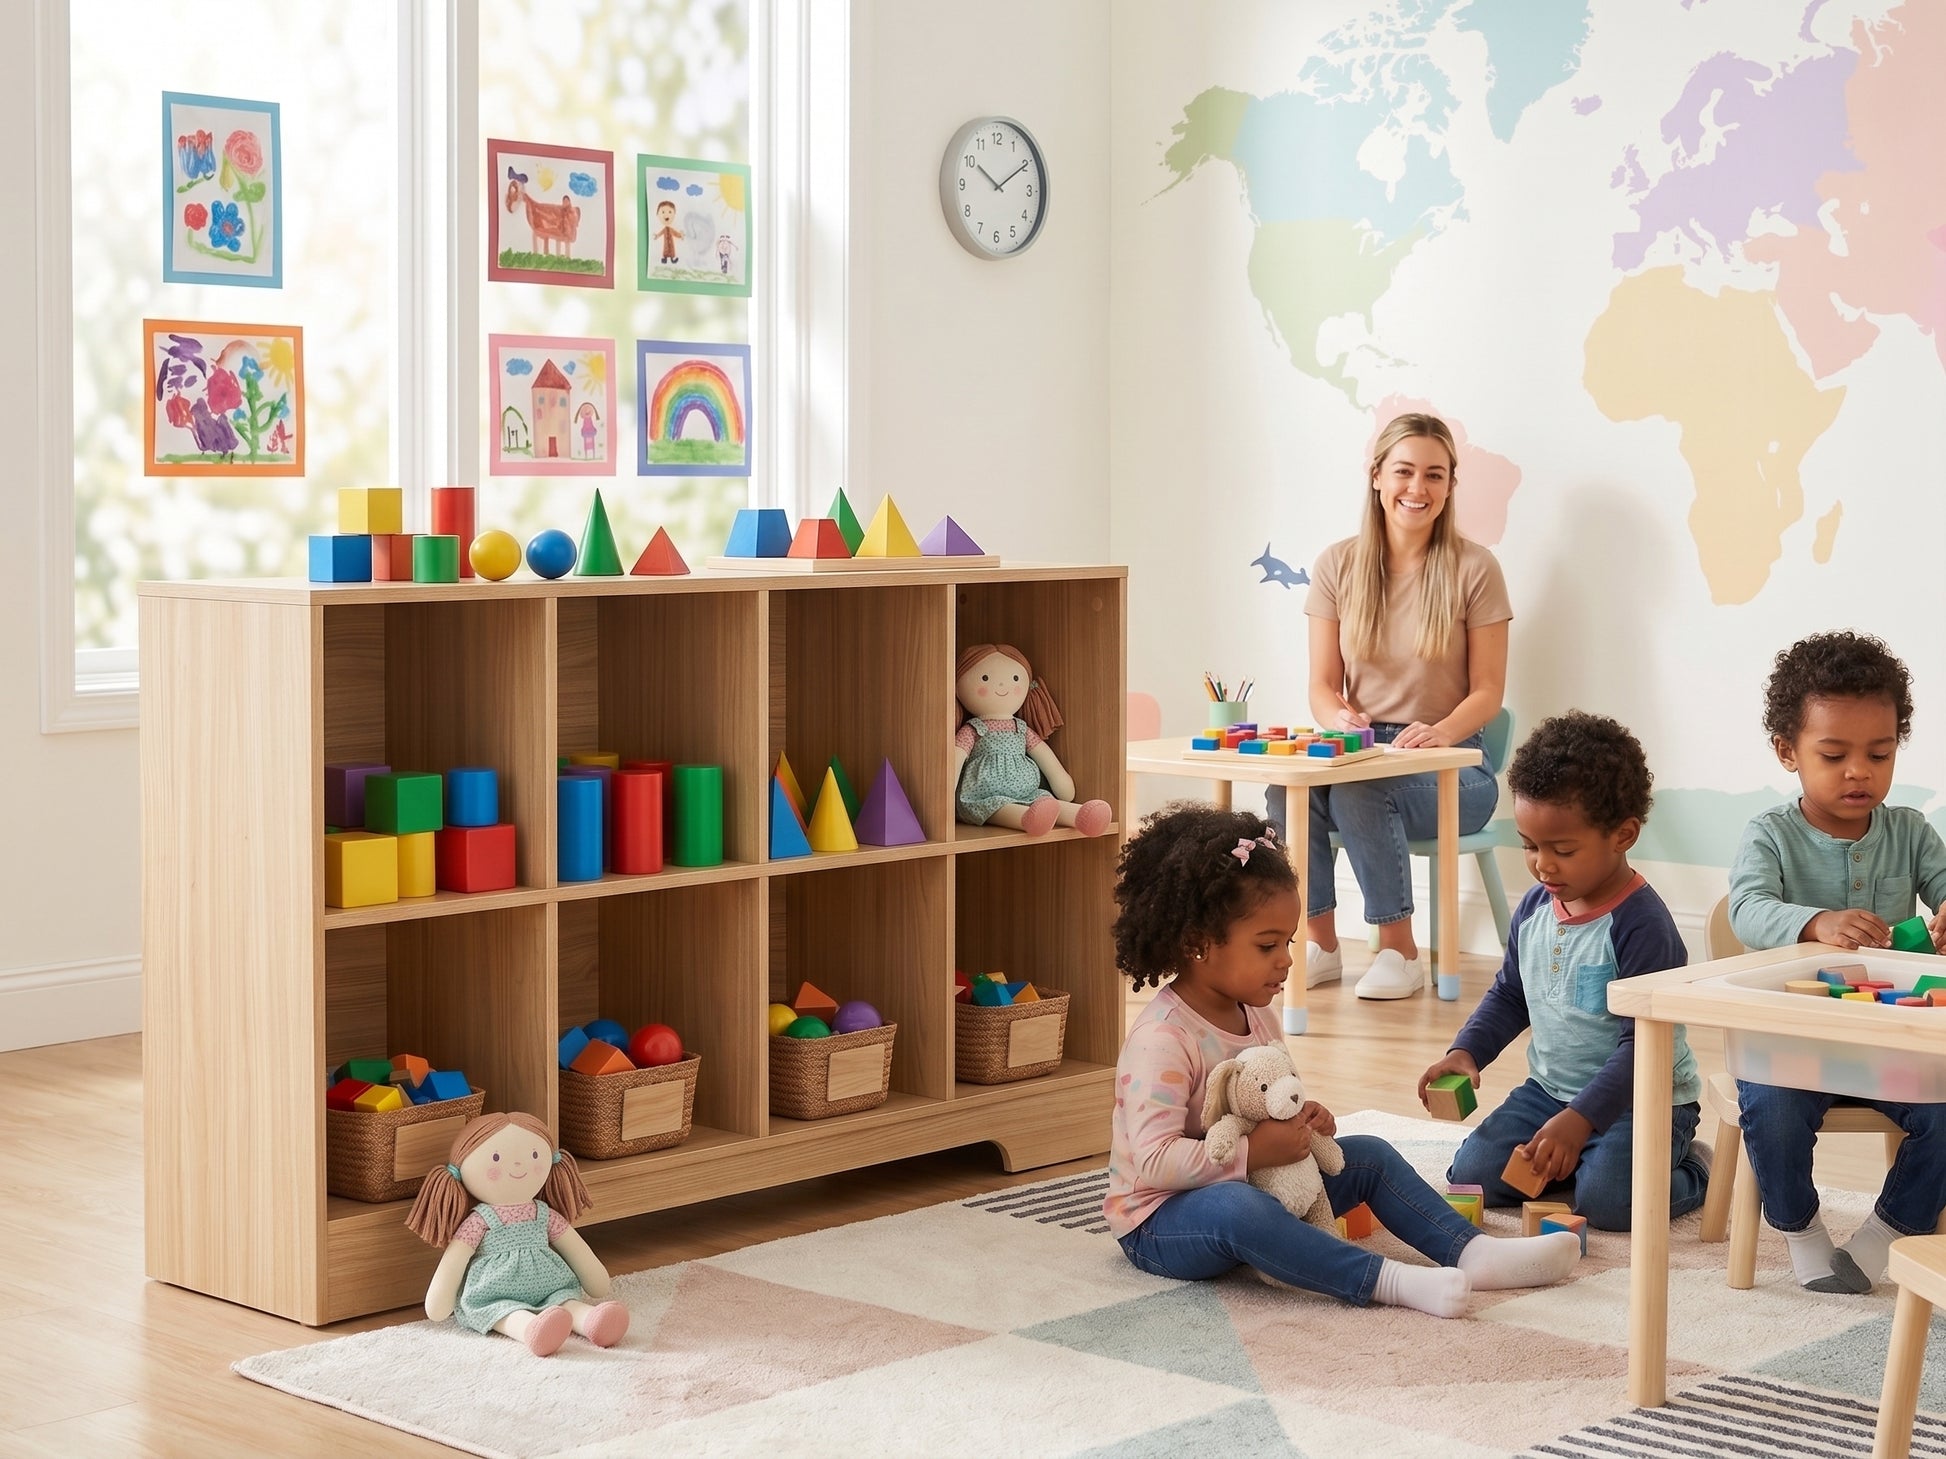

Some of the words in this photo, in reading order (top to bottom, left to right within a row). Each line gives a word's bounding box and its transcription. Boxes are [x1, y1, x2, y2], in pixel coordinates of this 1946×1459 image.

[976, 138, 985, 151] 11
[991, 132, 1002, 146] 12
[1011, 141, 1016, 152] 1
[964, 155, 975, 168] 10
[1022, 159, 1029, 172] 2
[959, 178, 966, 191] 9
[1026, 185, 1033, 197] 3
[964, 204, 971, 217] 8
[1021, 209, 1028, 221] 4
[977, 222, 983, 234] 7
[1009, 226, 1016, 238] 5
[993, 231, 1000, 243] 6
